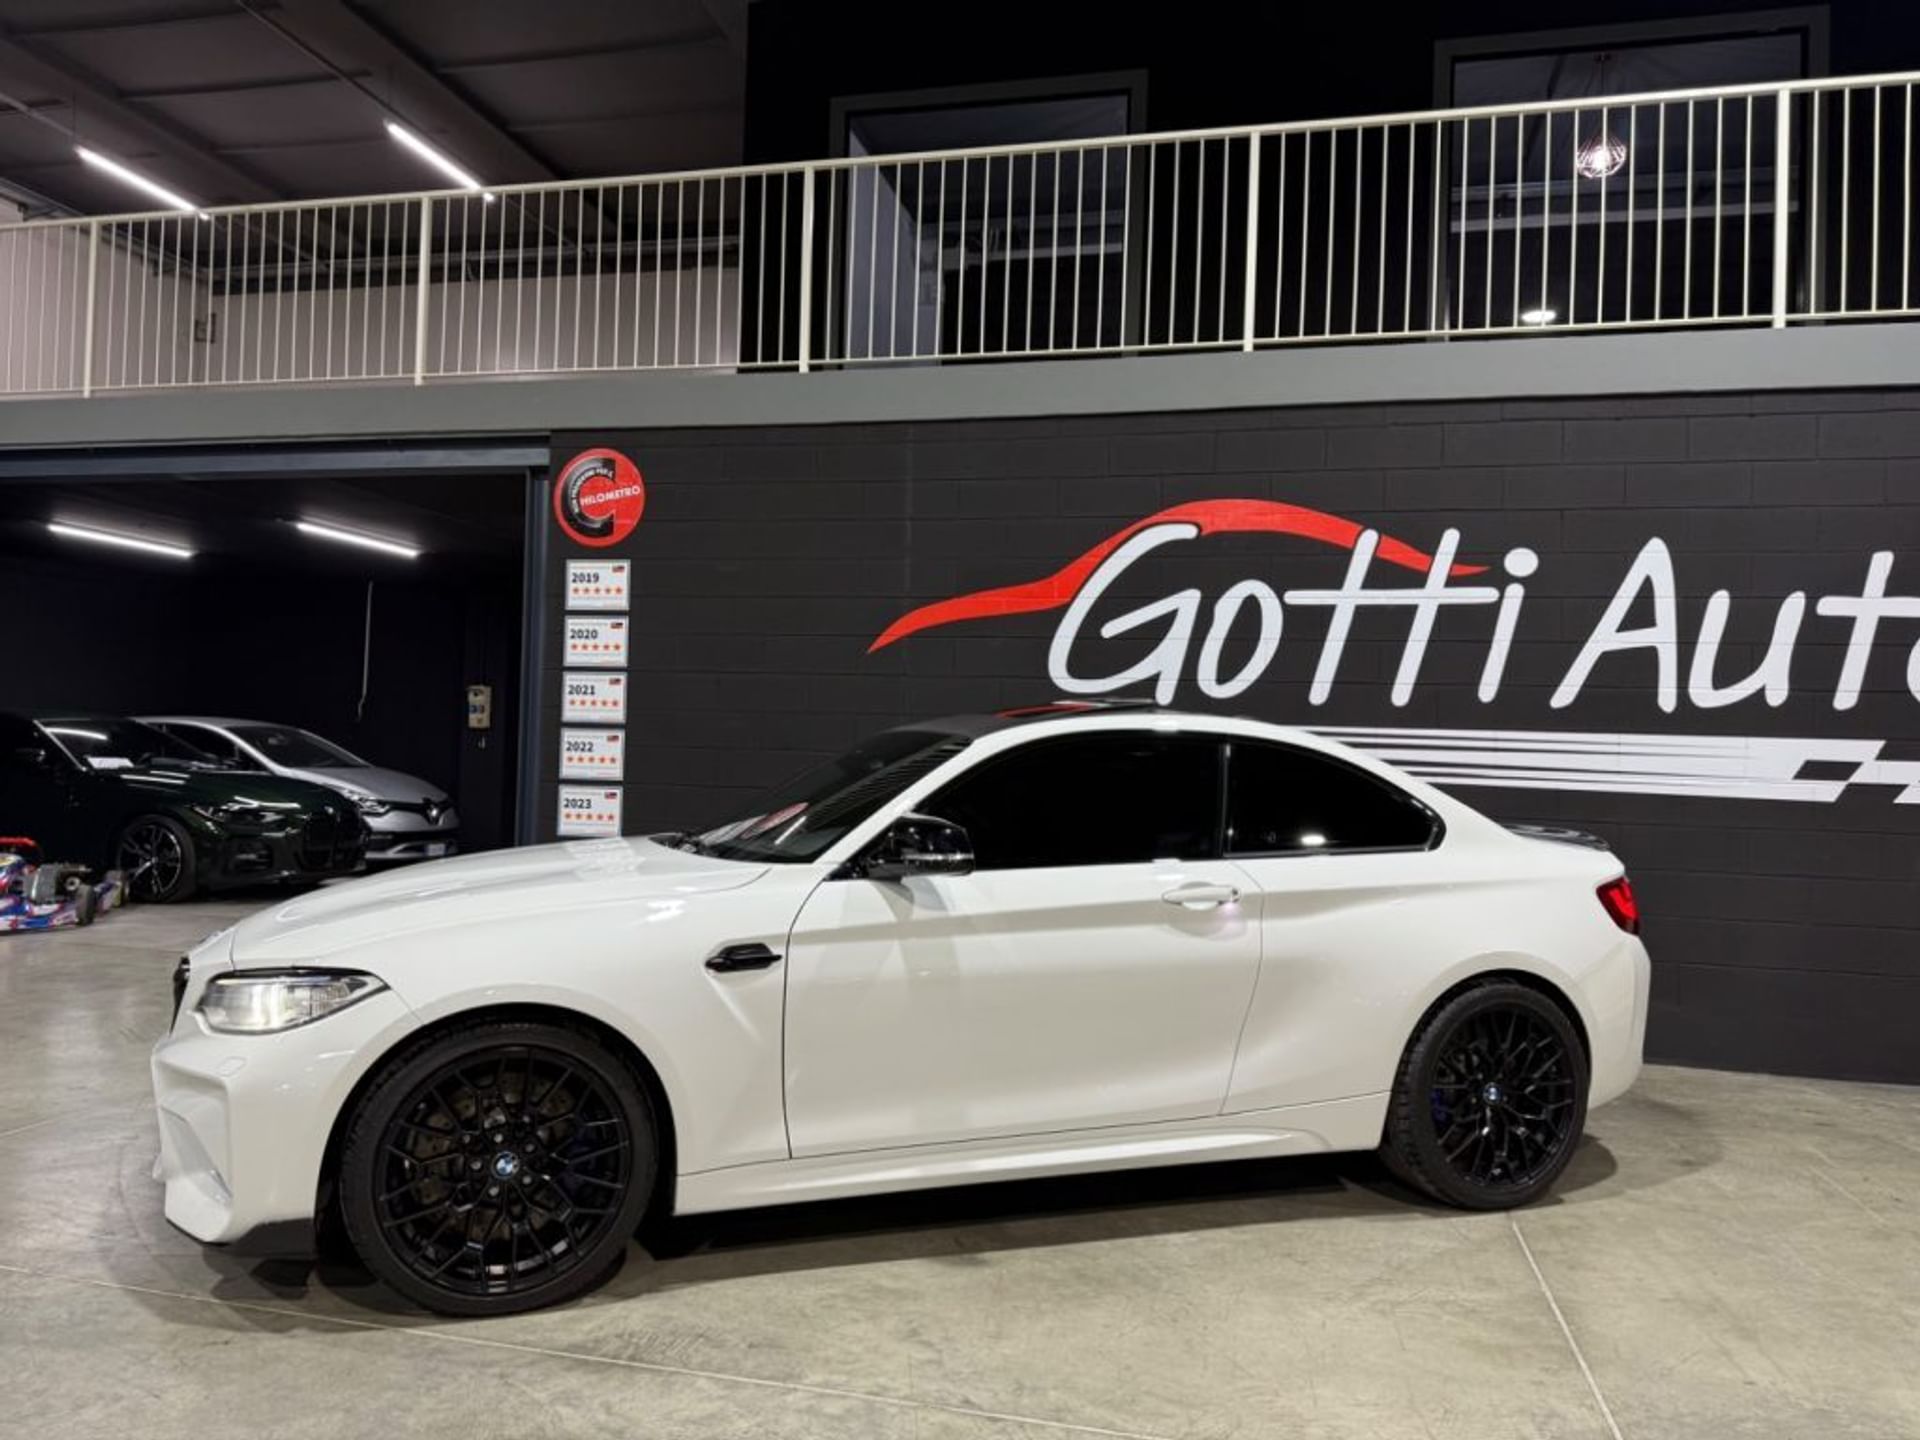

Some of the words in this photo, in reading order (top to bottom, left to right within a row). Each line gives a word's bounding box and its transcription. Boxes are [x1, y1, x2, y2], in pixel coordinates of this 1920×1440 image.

[571, 572, 600, 584] 2019
[1048, 523, 1539, 707] Gotti
[1549, 536, 1920, 713] Aut
[570, 629, 598, 640] 2020
[568, 685, 596, 695] 2021
[565, 741, 594, 752] 2022
[563, 798, 592, 809] 2023
